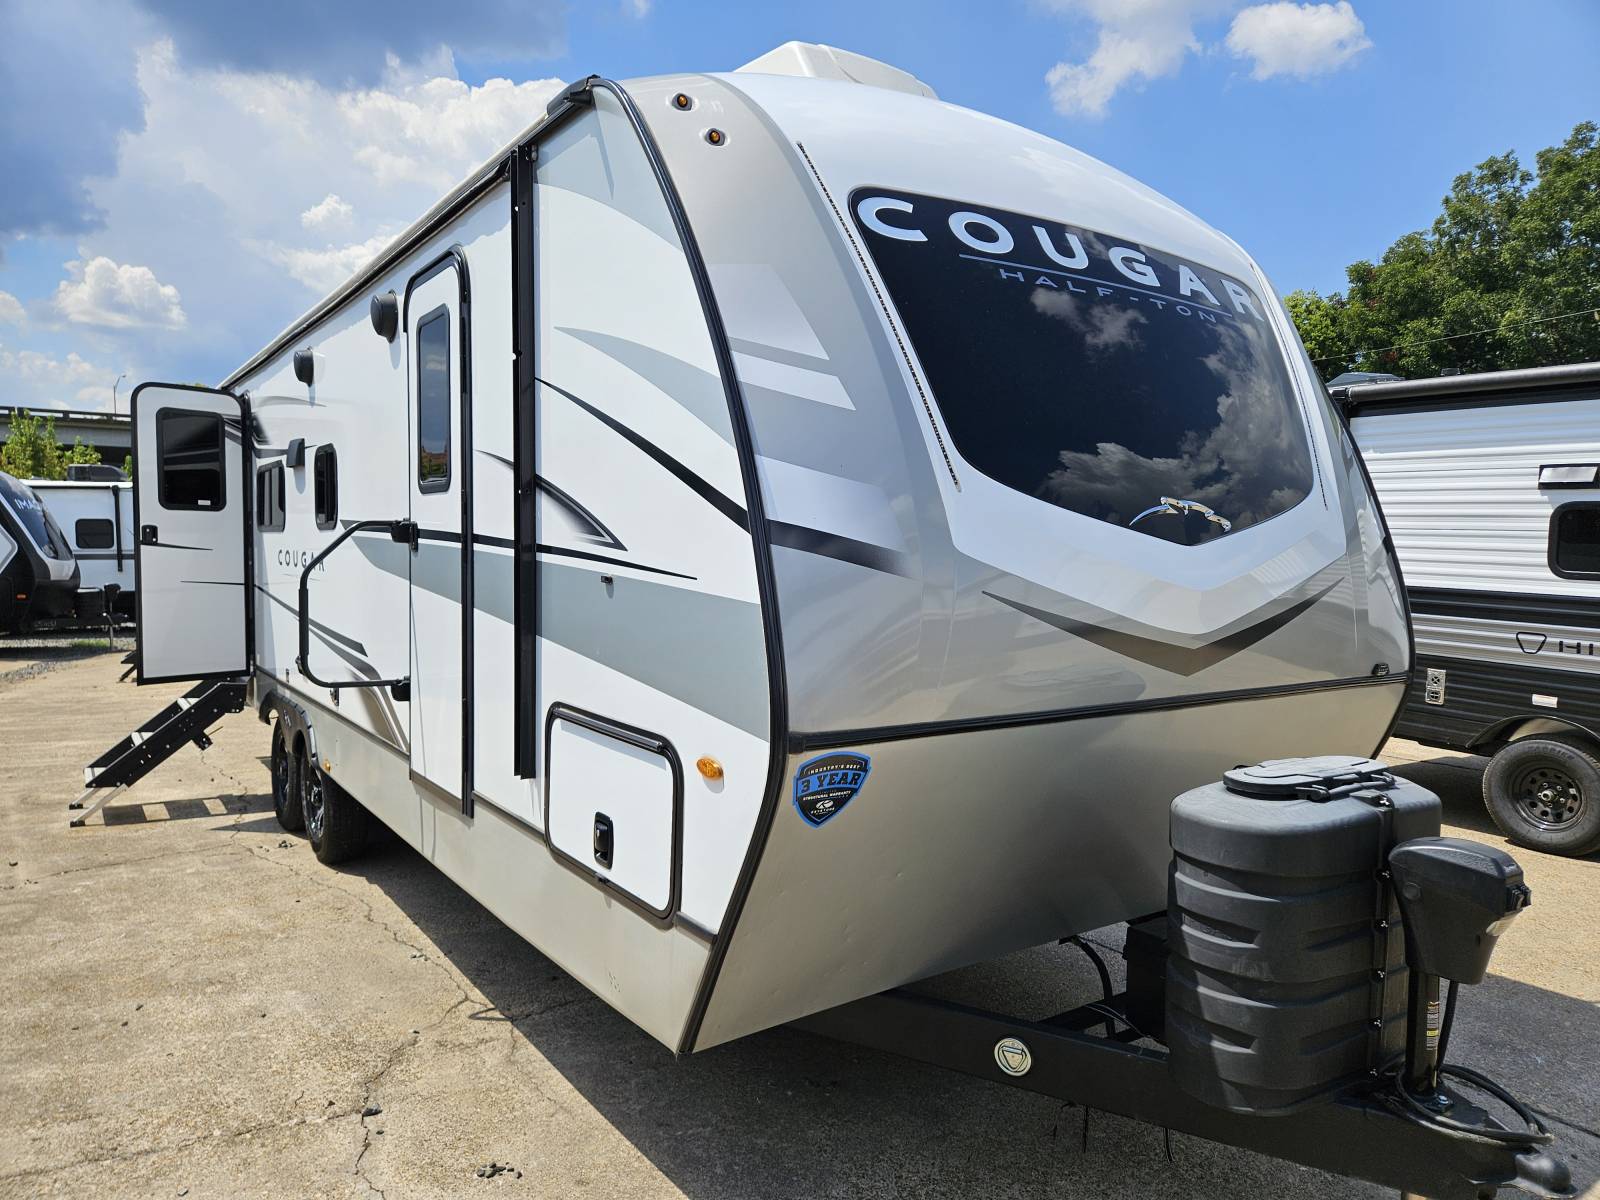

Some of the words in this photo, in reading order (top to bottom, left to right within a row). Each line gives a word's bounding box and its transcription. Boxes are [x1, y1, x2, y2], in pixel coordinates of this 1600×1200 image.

[857, 196, 1262, 320] COUGAR
[1000, 268, 1219, 323] HALF-TON
[800, 778, 811, 794] 3
[816, 771, 862, 788] YEAR
